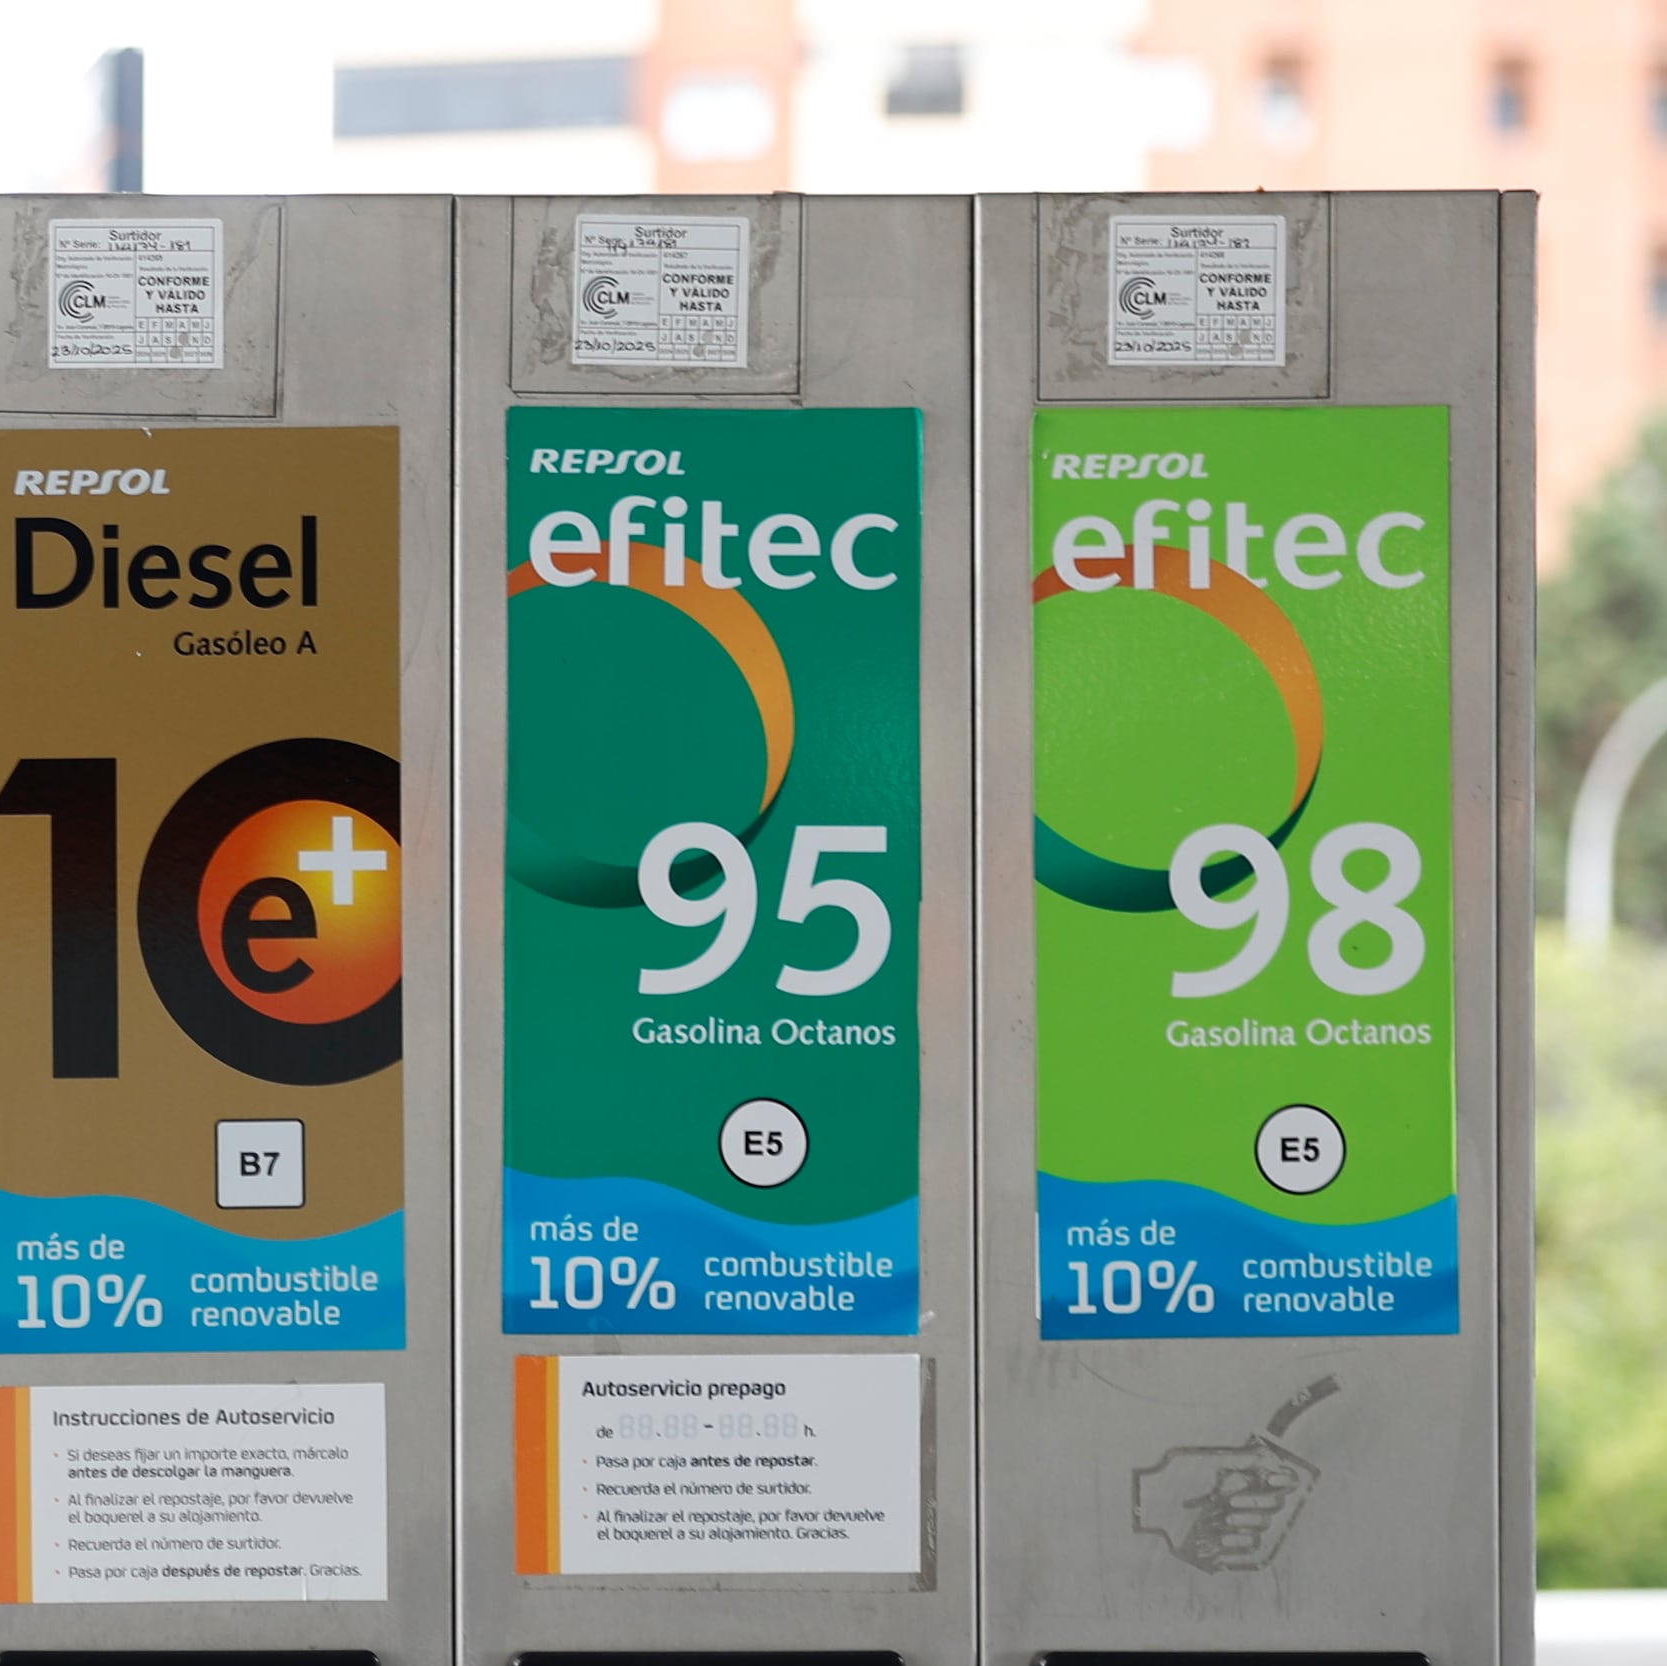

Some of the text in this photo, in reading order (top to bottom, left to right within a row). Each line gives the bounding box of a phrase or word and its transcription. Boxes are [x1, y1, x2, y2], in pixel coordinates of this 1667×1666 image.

[109, 230, 162, 241] Surtidor
[635, 227, 687, 238] Surtidor
[1171, 227, 1224, 238] Surtidor
[138, 277, 210, 287] CONFORME
[663, 274, 734, 285] CONFORME
[1200, 273, 1272, 284] CONFORME
[73, 295, 106, 308] CLM
[146, 290, 154, 300] Y
[598, 292, 629, 304] CLM
[670, 288, 679, 297] Y
[1134, 292, 1167, 305] CLM
[1207, 288, 1215, 297] Y
[156, 303, 199, 314] HASTA
[680, 301, 722, 312] HASTA
[1217, 300, 1260, 311] HASTA
[530, 448, 685, 476] REPSOL
[1051, 452, 1208, 480] REPSOL
[14, 468, 170, 496] REPSOL
[528, 495, 899, 591] efitec
[1052, 498, 1426, 593] efitec
[15, 515, 318, 610] Diesel
[174, 630, 317, 656] Gasóleo A
[637, 821, 892, 997] 95
[1169, 822, 1427, 999] 98
[632, 1017, 897, 1046] Gasolina Octanos
[1166, 1019, 1432, 1048] Gasolina Octanos
[744, 1131, 784, 1156] E5
[1280, 1137, 1320, 1163] E5
[240, 1151, 280, 1177] B7
[530, 1214, 640, 1242] más de
[1067, 1218, 1177, 1246] más de
[17, 1233, 126, 1261] más de
[705, 1251, 894, 1279] combustible
[1243, 1252, 1434, 1280] combustible
[191, 1266, 379, 1295] combustible
[530, 1256, 676, 1311] 10%
[1067, 1260, 1215, 1316] 10%
[16, 1275, 163, 1330] 10%
[705, 1285, 855, 1312] renovable
[1243, 1286, 1395, 1314] renovable
[191, 1300, 341, 1328] renovable
[582, 1380, 786, 1400] Autoservicio prepago
[53, 1408, 335, 1426] Instrucciones de Autoservicio
[83, 1447, 349, 1463] deseas fijar importe márcalo
[596, 1456, 629, 1468] Pasa
[633, 1457, 655, 1470] por
[659, 1455, 687, 1470] caja
[691, 1456, 730, 1467] antes
[734, 1455, 751, 1466] de
[68, 1467, 107, 1478] antes
[111, 1466, 128, 1478] de
[133, 1465, 201, 1480] descolgar
[596, 1483, 660, 1495] Recuerda
[681, 1481, 733, 1495] número
[85, 1491, 353, 1507] finalizar repostaje, por favor devuelve
[85, 1510, 144, 1525] boquerel
[615, 1509, 885, 1525] finalizar repostaje, por favor devuelve
[69, 1536, 203, 1551] Recuerda número
[614, 1528, 673, 1542] boquerel
[797, 1528, 849, 1539] Gracias.
[69, 1566, 101, 1578] Pasa
[105, 1567, 127, 1581] por
[131, 1565, 158, 1580] caja
[163, 1564, 219, 1579] después
[224, 1564, 241, 1576] de
[310, 1564, 363, 1576] Gracias.
